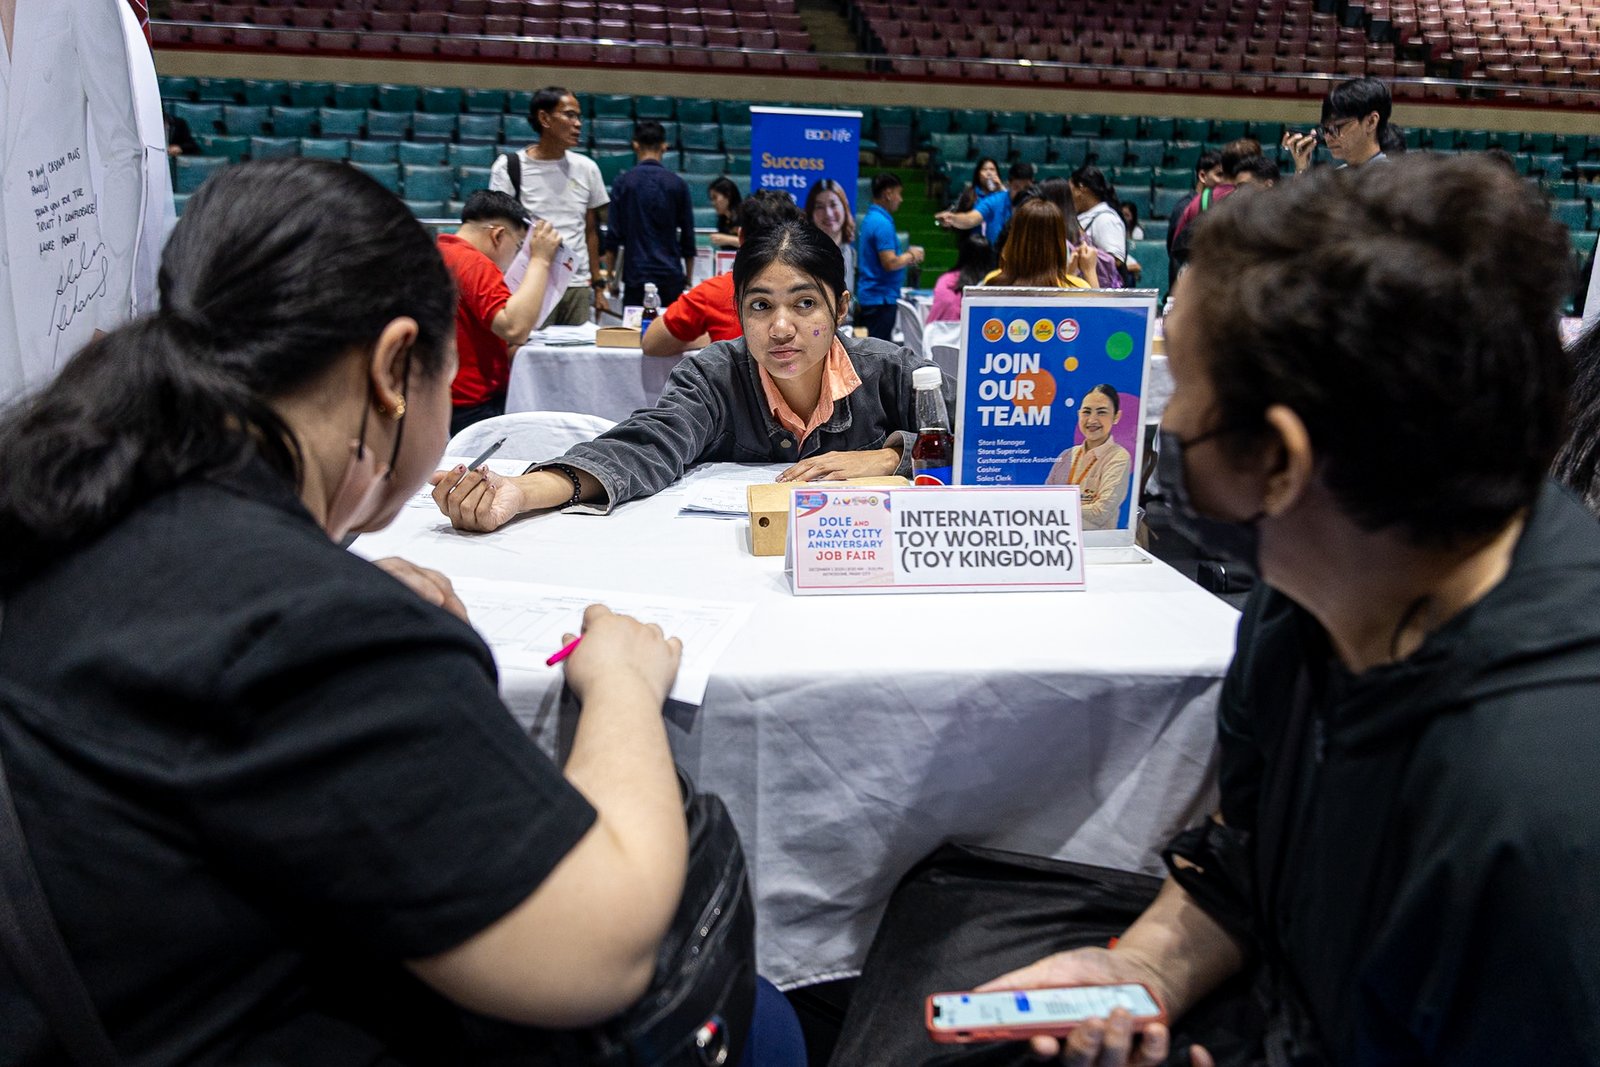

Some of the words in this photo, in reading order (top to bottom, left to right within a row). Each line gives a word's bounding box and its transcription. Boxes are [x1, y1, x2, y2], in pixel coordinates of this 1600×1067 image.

[761, 152, 825, 171] Success
[760, 173, 808, 189] starts
[979, 353, 1041, 374] JOIN
[978, 379, 1036, 401] OUR
[977, 405, 1052, 427] TEAM
[996, 439, 1026, 447] Manager
[996, 448, 1031, 456] Supervisor
[819, 516, 852, 527] DOLE
[900, 510, 1071, 528] INTERNATIONAL
[808, 529, 849, 539] PASAY
[852, 528, 882, 538] CITY
[894, 530, 940, 548] TOY
[944, 530, 1030, 549] WORLD,
[1034, 529, 1078, 547] INC.
[808, 540, 884, 549] ANNIVERSARY
[815, 550, 842, 561] JOB
[846, 550, 876, 561] FAIR
[901, 546, 956, 573] (TOY
[960, 545, 1074, 571] KINGDOM)
